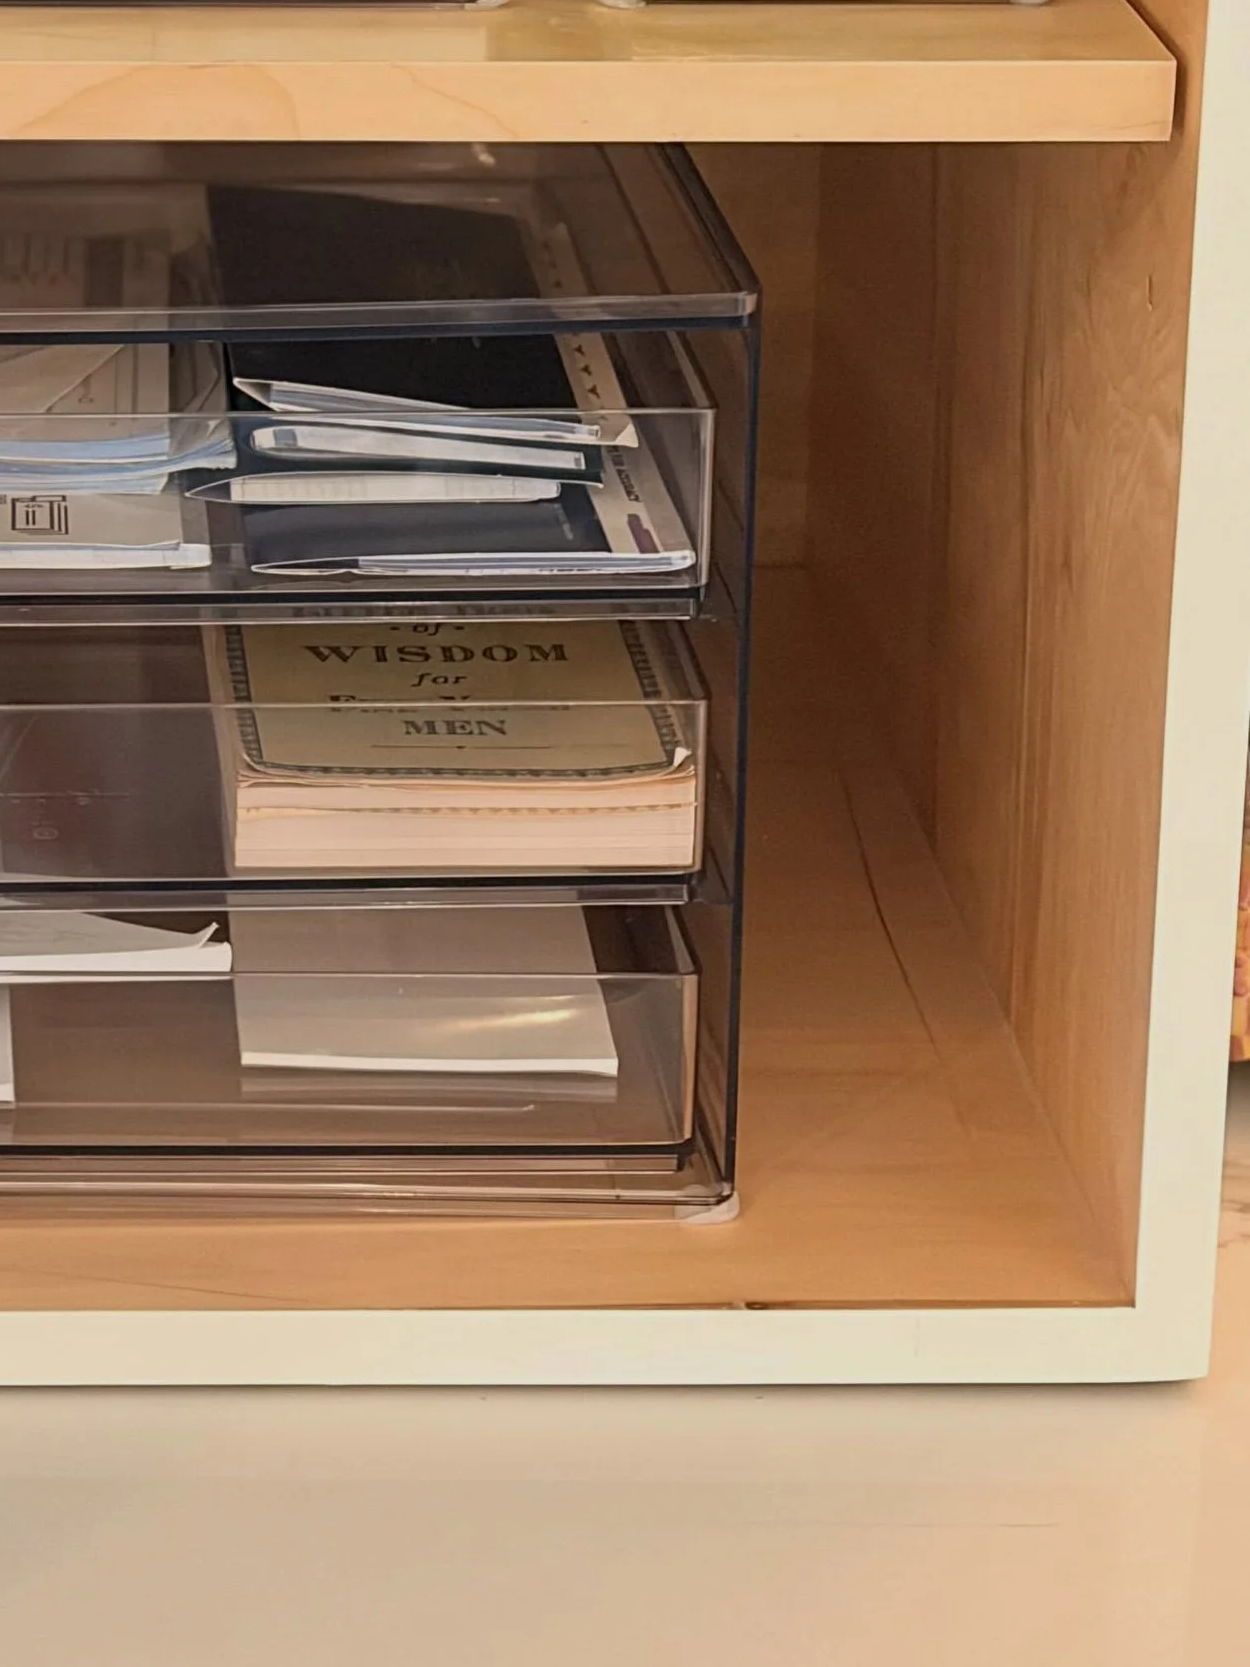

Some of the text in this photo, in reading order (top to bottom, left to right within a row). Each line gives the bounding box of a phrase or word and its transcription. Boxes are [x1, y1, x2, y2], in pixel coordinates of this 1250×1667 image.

[303, 643, 570, 665] WISDOM
[411, 672, 468, 688] for
[402, 718, 508, 737] MEN
